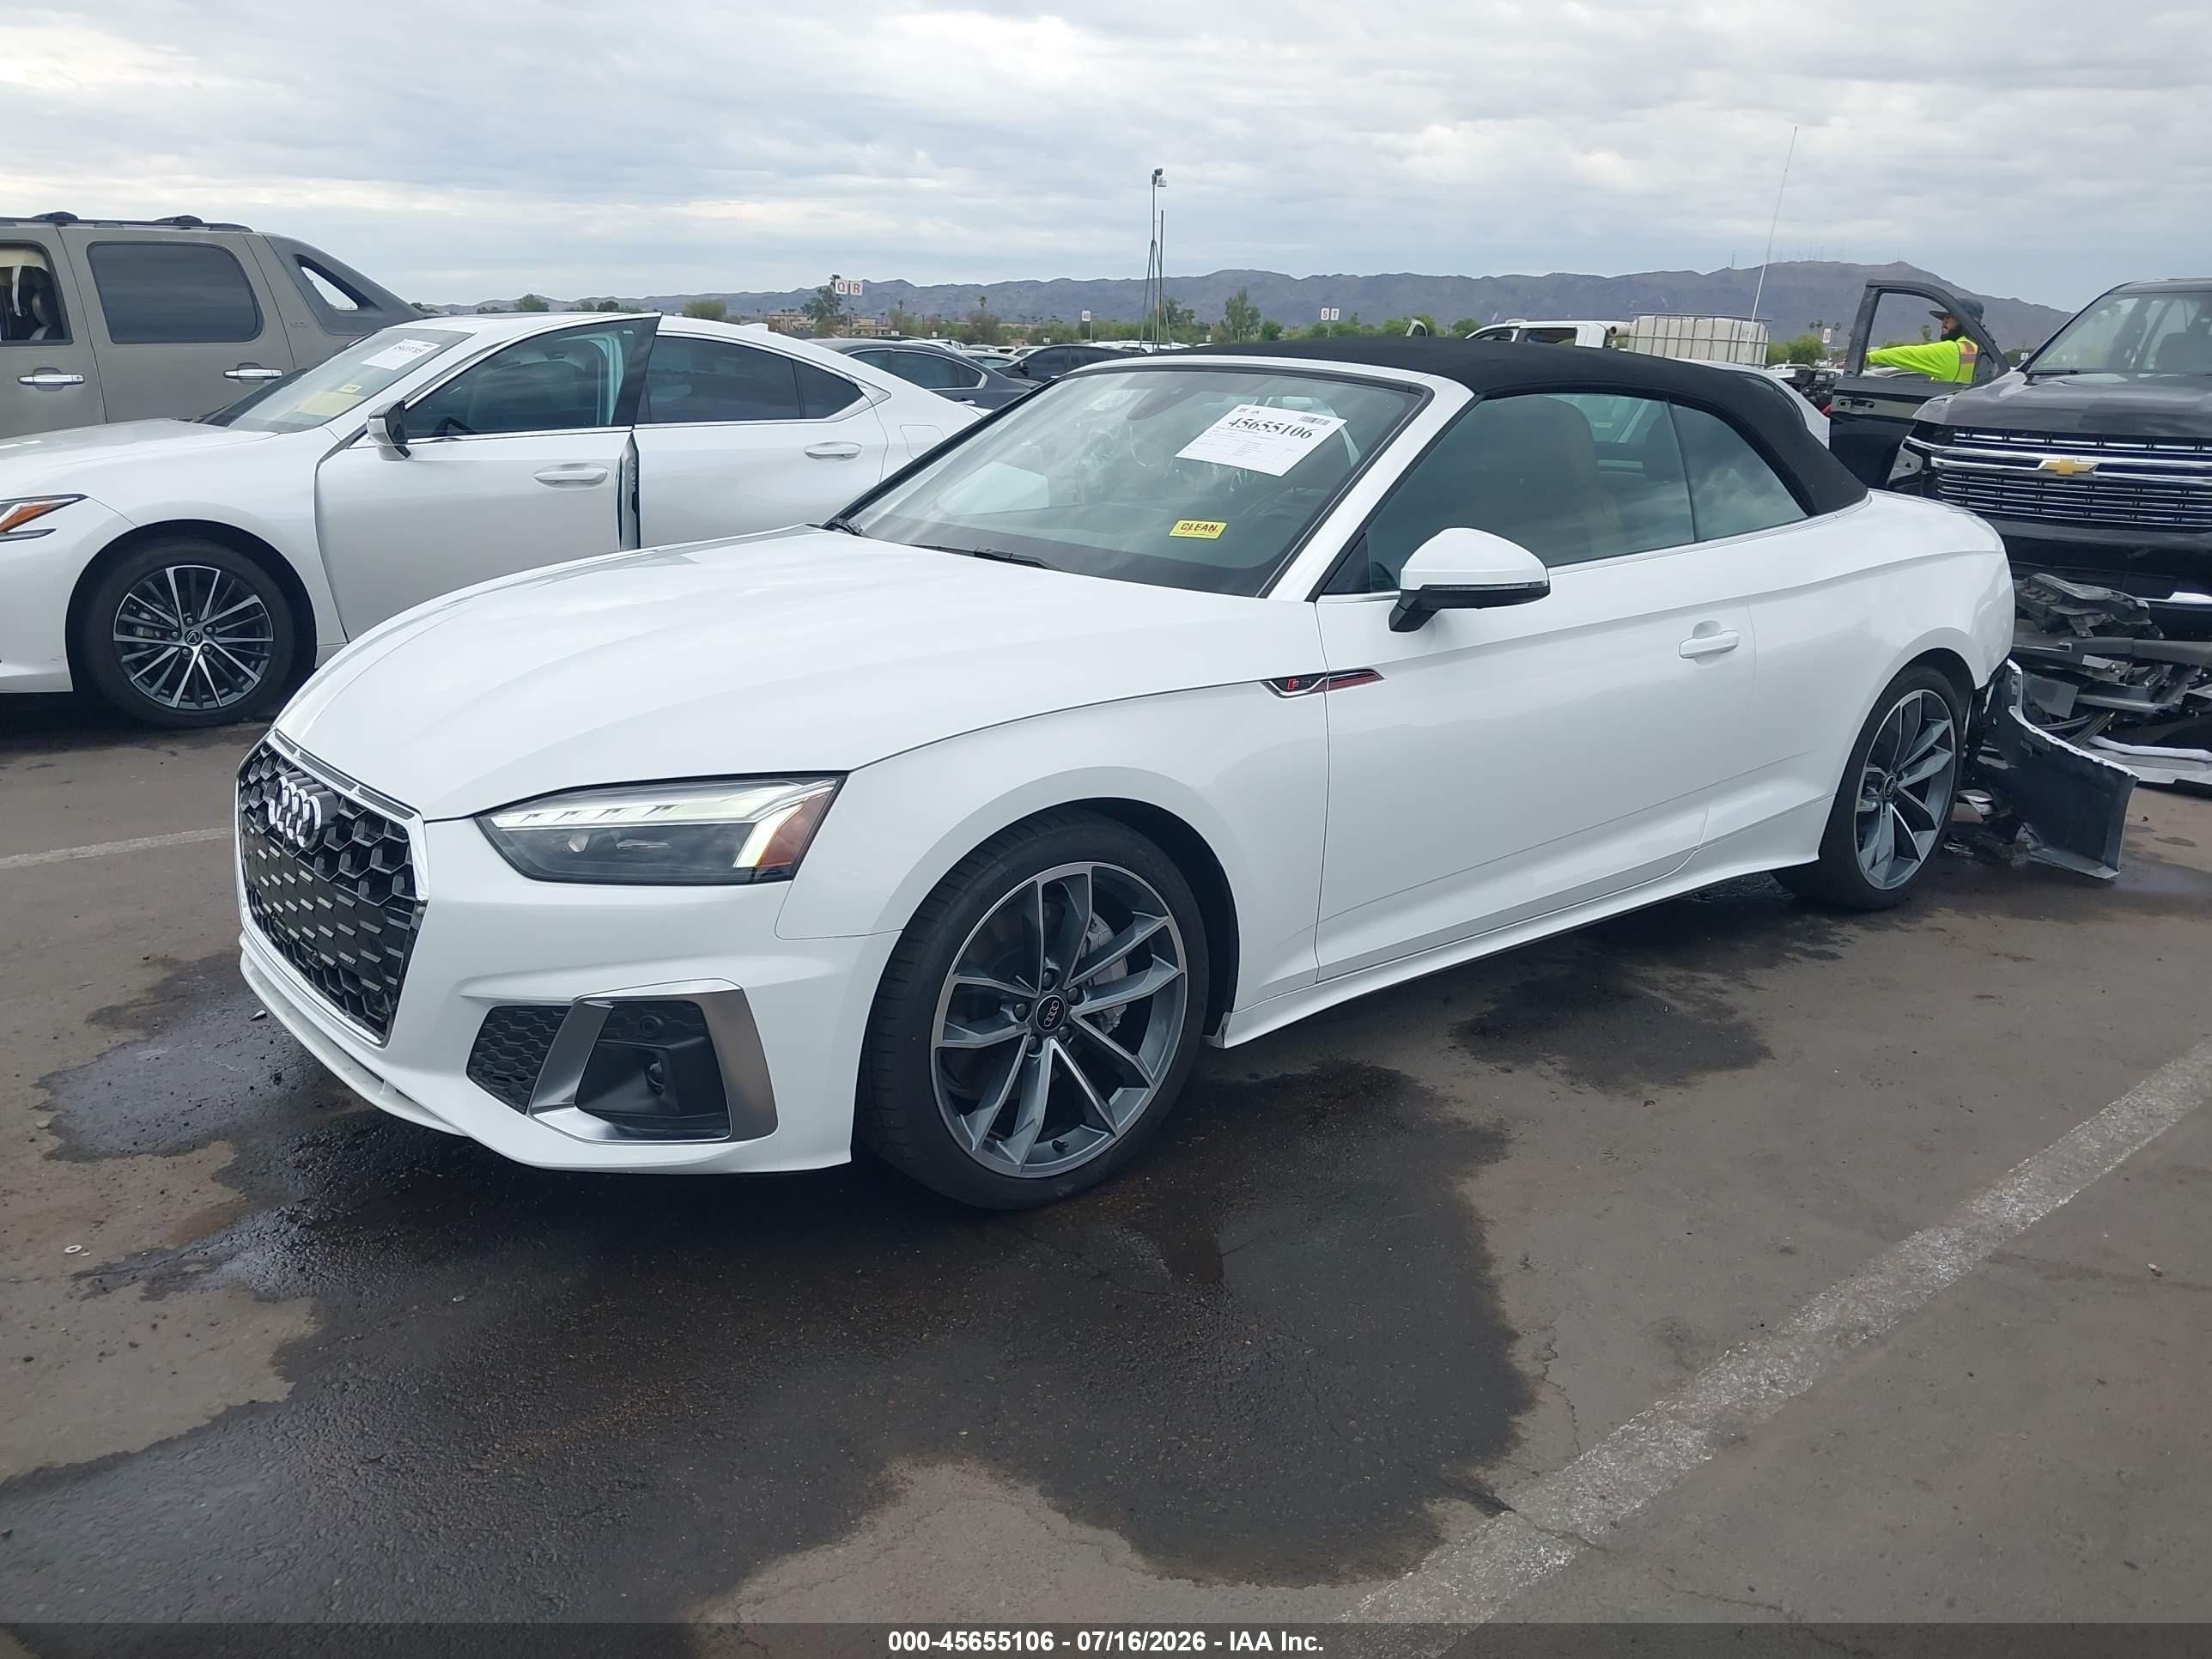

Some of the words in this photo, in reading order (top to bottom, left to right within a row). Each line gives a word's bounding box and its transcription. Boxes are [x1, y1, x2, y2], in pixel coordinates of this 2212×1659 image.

[837, 282, 846, 293] Q
[853, 283, 860, 294] R
[1227, 417, 1320, 440] 45655106
